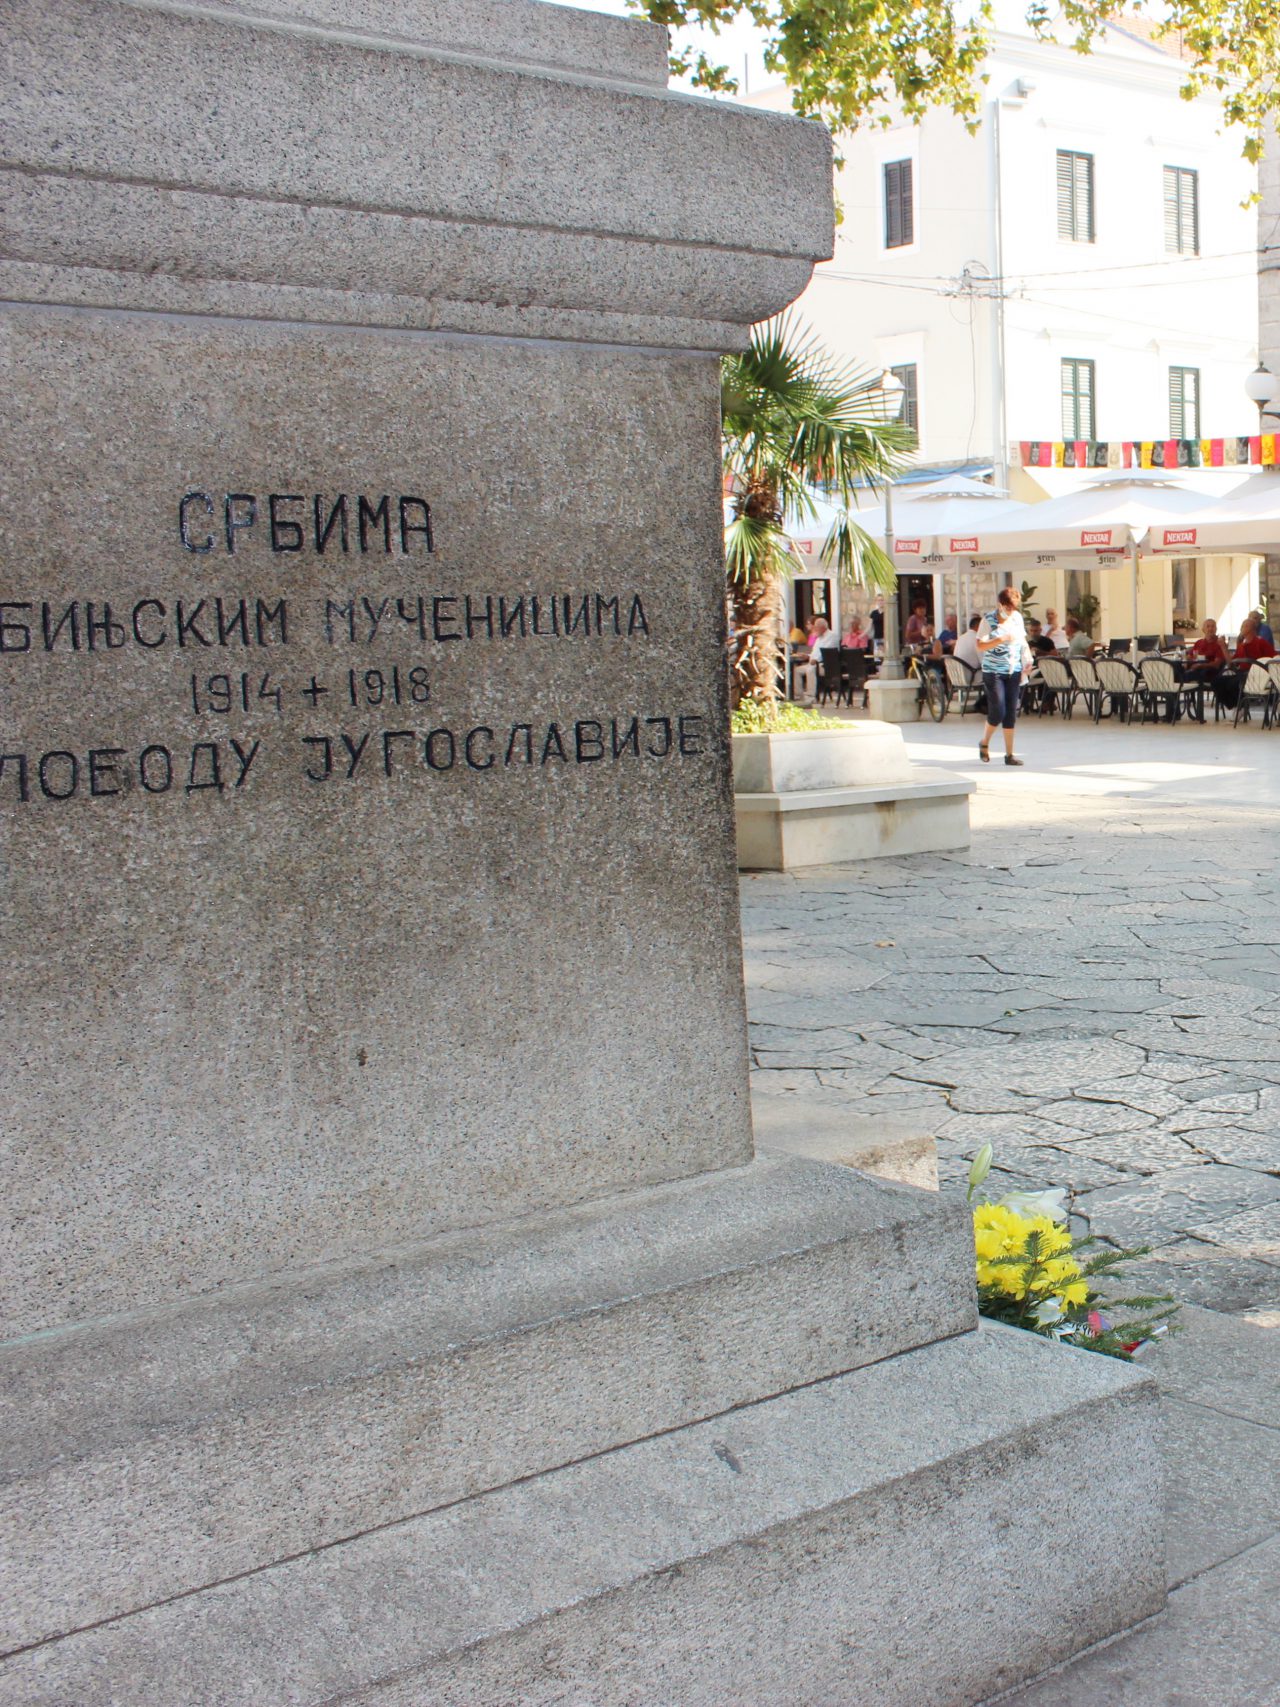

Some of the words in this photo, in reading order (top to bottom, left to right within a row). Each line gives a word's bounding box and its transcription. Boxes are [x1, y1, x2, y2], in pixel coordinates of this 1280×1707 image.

[180, 493, 434, 555] СРБИМА
[1167, 533, 1193, 543] NEKTAR
[326, 593, 650, 643] МУЧЕНИЦИМА
[192, 672, 282, 715] 1914
[349, 666, 431, 706] 1918
[302, 715, 704, 780] ЈУГОСЛАВИЈЕ
